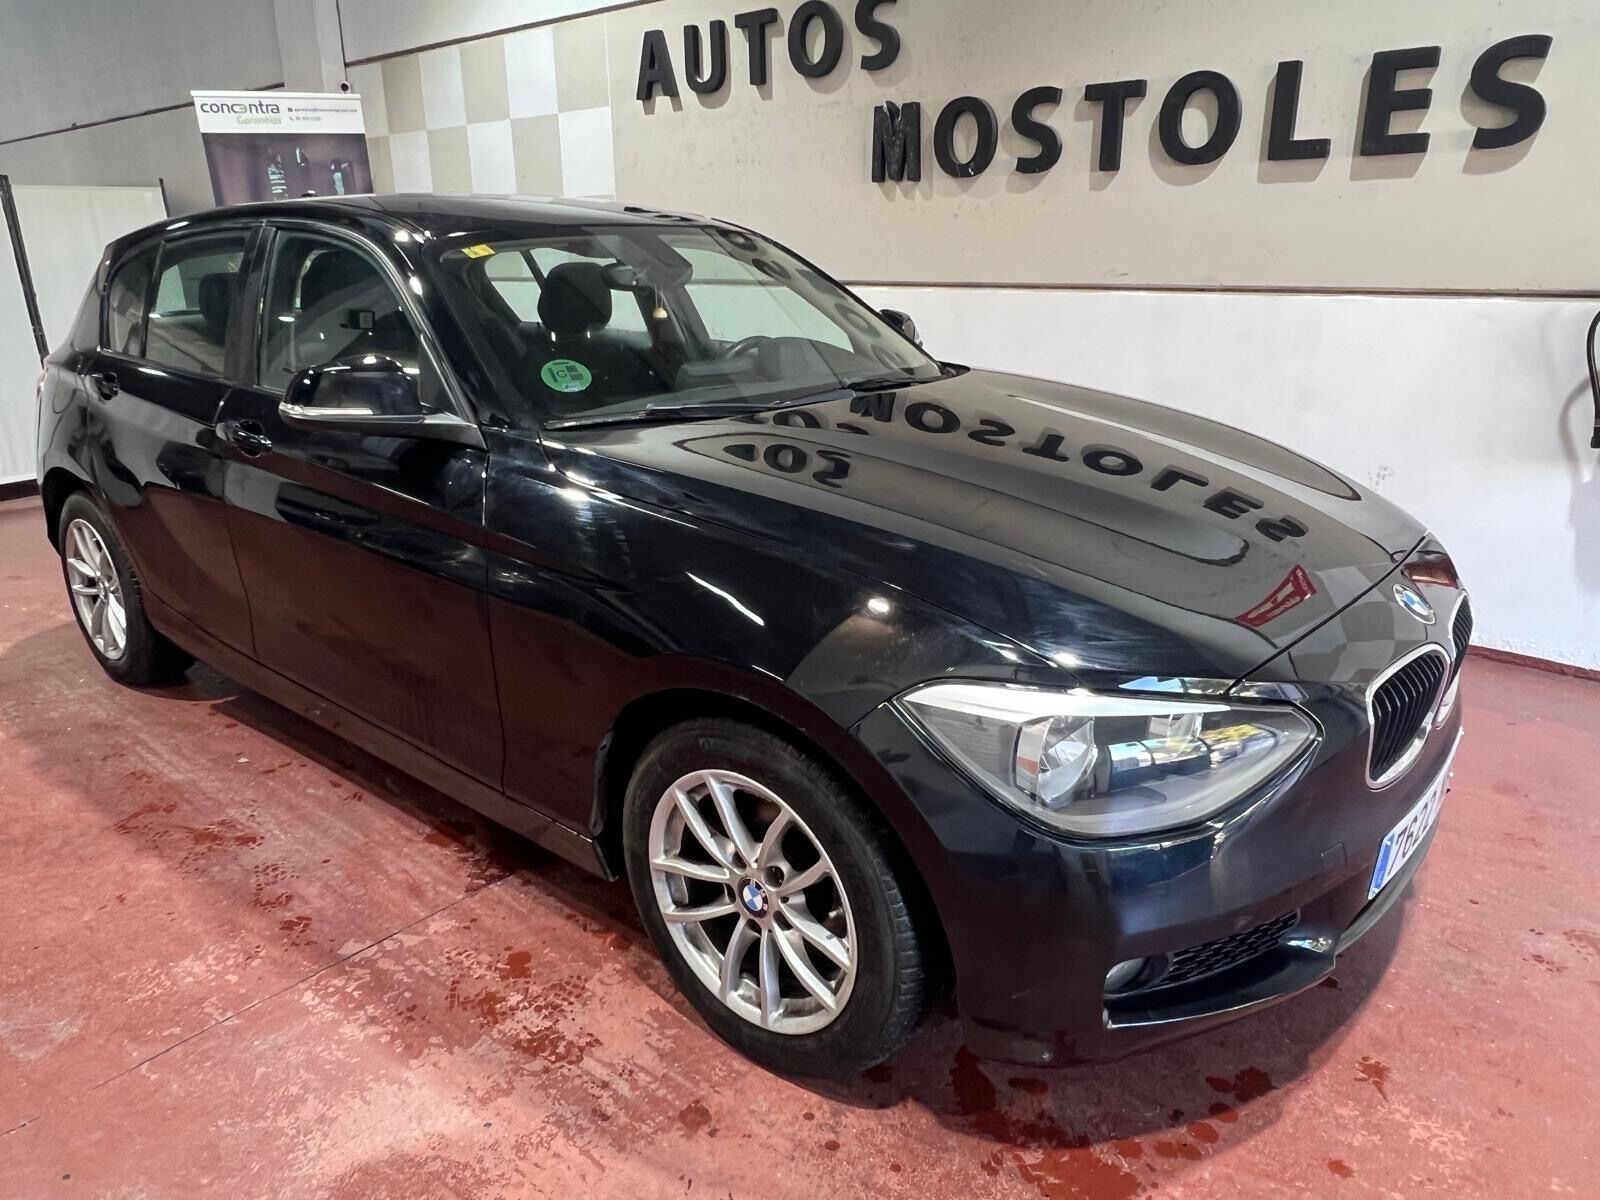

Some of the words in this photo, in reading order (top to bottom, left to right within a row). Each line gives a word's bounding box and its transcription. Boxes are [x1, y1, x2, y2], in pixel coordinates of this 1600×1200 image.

[636, 0, 900, 101] AUTOS
[200, 101, 280, 114] concentra
[871, 34, 1553, 183] MOSTOLES
